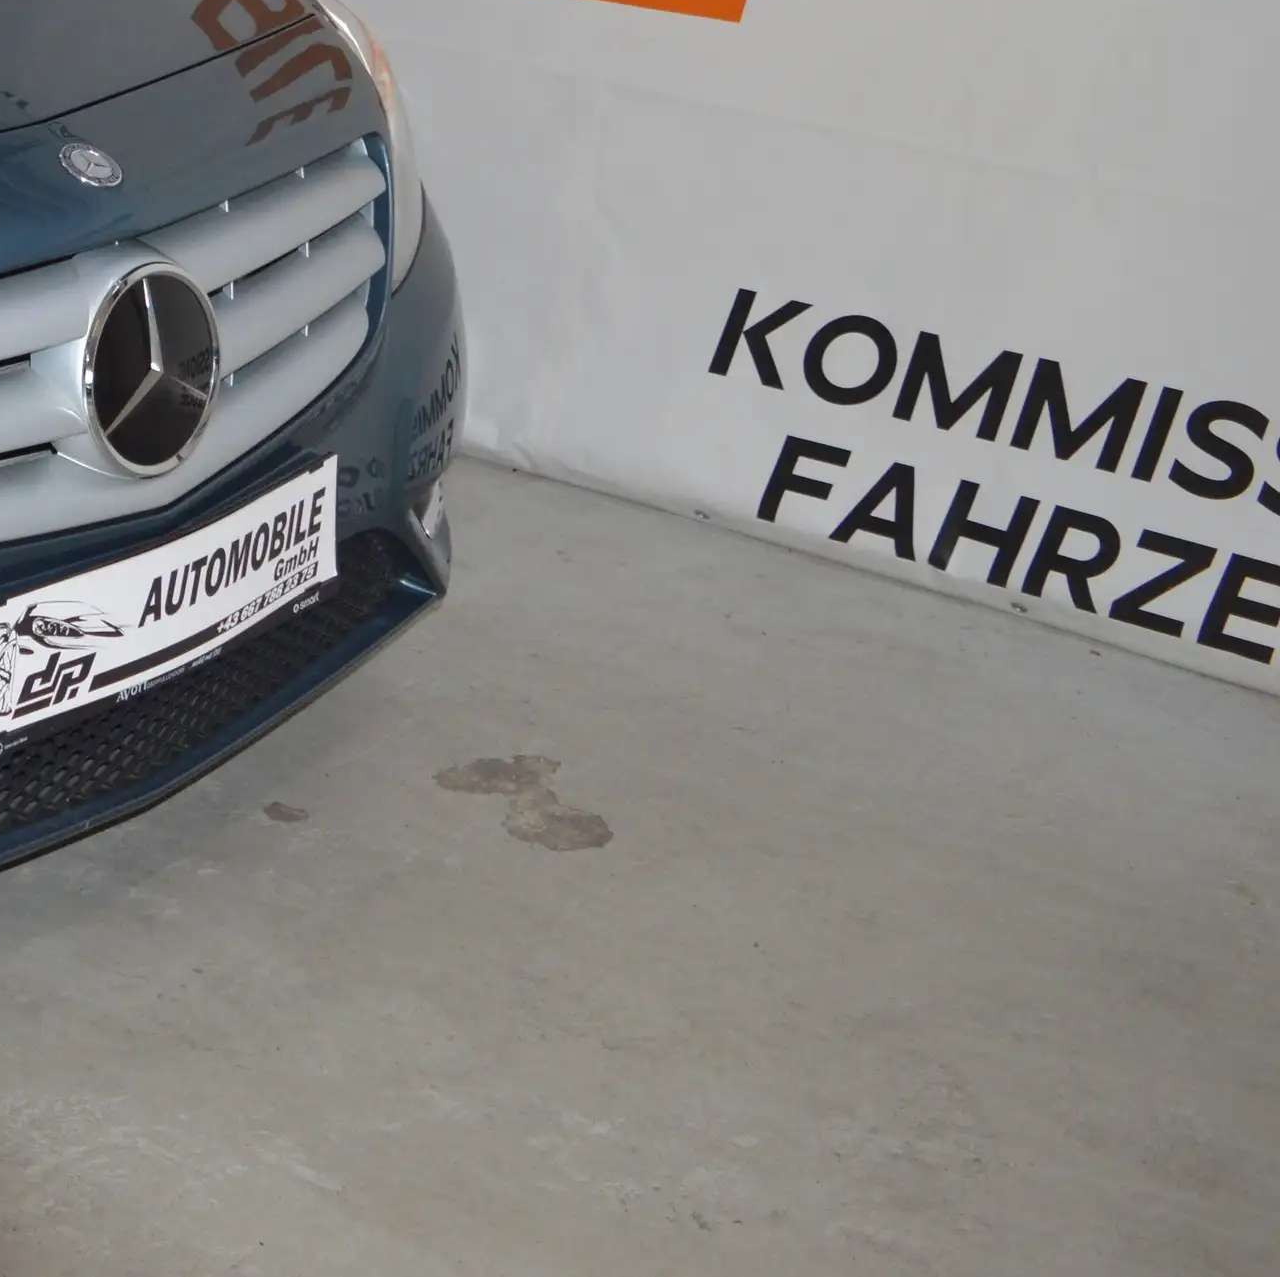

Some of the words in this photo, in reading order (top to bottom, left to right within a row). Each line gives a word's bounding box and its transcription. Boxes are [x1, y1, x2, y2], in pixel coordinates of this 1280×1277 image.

[708, 288, 1280, 516] KOMMIS
[137, 486, 327, 629] AUTOMOBILE
[216, 610, 240, 633] +43
[240, 596, 263, 621] 667
[299, 563, 317, 584] 75
[273, 536, 320, 582] GmbH
[756, 435, 1280, 665] FAHRZE
